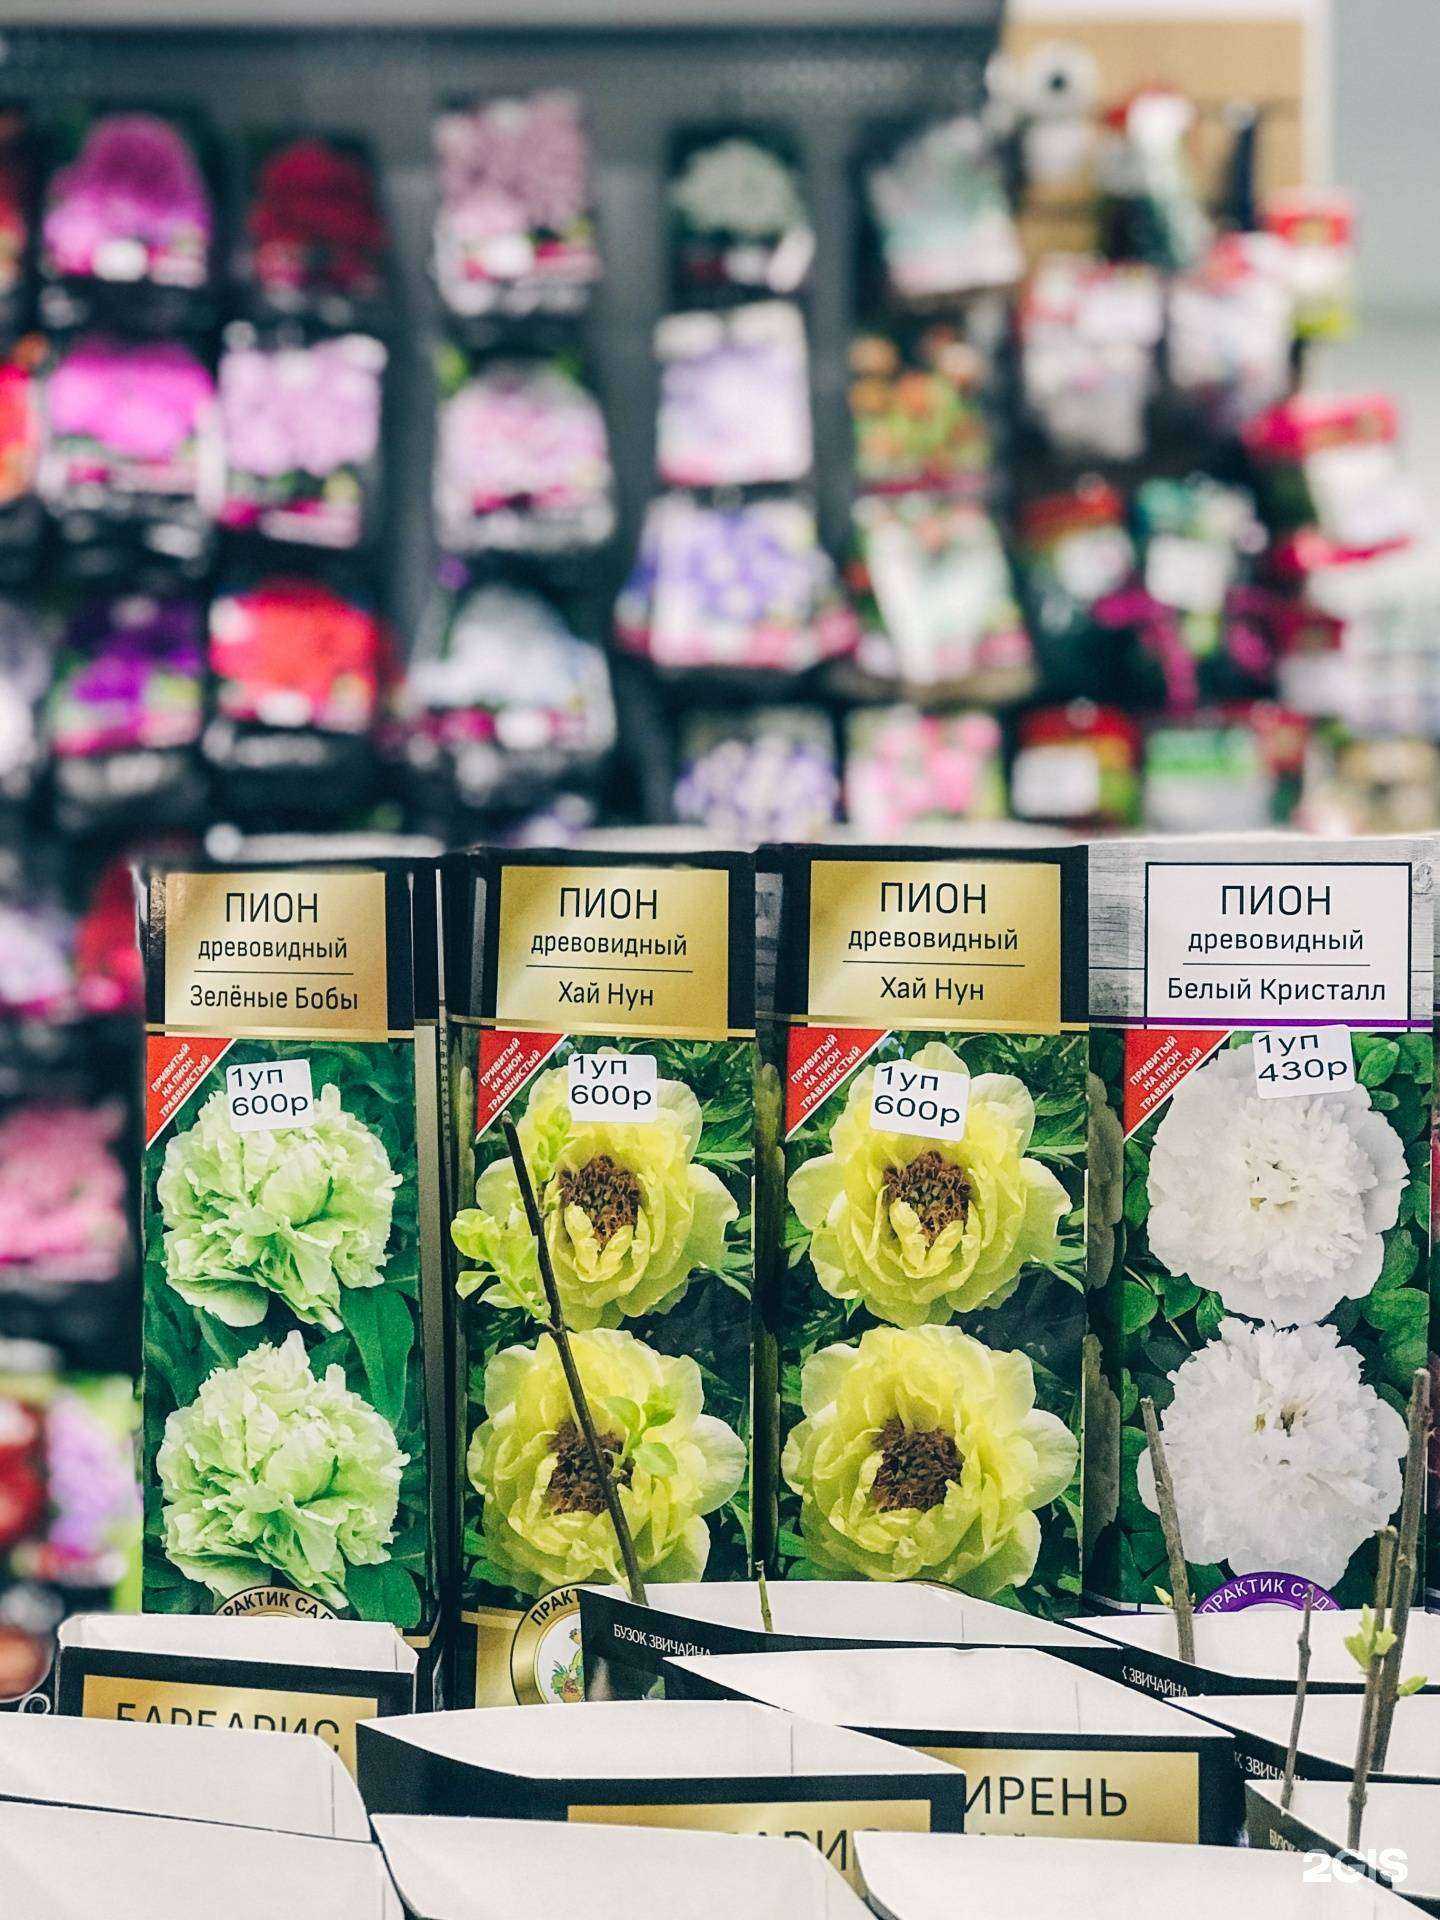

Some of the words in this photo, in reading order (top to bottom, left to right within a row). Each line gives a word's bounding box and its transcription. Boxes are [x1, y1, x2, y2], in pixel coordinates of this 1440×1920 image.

[226, 892, 318, 923] ПИОН
[560, 887, 657, 919] ПИОН
[881, 882, 986, 914] ПИОН
[1221, 885, 1330, 916] ПИОН
[199, 937, 347, 961] древовидный
[531, 934, 687, 957] древовидный
[849, 929, 1018, 952] древовидный
[1188, 929, 1363, 953] древовидный
[191, 984, 287, 1008] Зелёные
[295, 987, 358, 1009] Бобы
[559, 981, 600, 1004] Хай
[608, 984, 653, 1010] Нун
[881, 977, 926, 1000] Хай
[936, 978, 984, 1005] Нун
[1168, 977, 1251, 1000] Белый
[1261, 979, 1386, 1005] Кристалл
[790, 1034, 838, 1085] ПРИВИТЫЙ
[1258, 1034, 1319, 1056] 1уп
[151, 1043, 190, 1093] ПРИВИТЫЙ
[480, 1038, 521, 1087] ПРИВИТЫЙ
[490, 1070, 508, 1092] НА
[503, 1052, 525, 1077] ПИОН
[574, 1055, 627, 1079] 1уп
[803, 1069, 822, 1090] НА
[816, 1049, 842, 1075] ПИОН
[1129, 1036, 1178, 1086] ПРИВИТЫЙ
[1142, 1072, 1162, 1092] НА
[1157, 1050, 1182, 1077] ПИОН
[1258, 1059, 1348, 1082] 430р
[159, 1055, 211, 1118] ТРАВЯНИСТЫЙ
[161, 1077, 178, 1096] НА
[173, 1058, 195, 1082] ПИОН
[232, 1068, 283, 1090] 1уп
[487, 1049, 541, 1111] ТРАВЯНИСТЫЙ
[801, 1046, 862, 1110] ТРАВЯНИСТЫЙ
[881, 1066, 938, 1092] 1уп
[1139, 1047, 1203, 1111] ТРАВЯНИСТЫЙ
[232, 1093, 308, 1116] 600р
[571, 1085, 651, 1110] 600р
[874, 1095, 960, 1127] 600р
[223, 1591, 290, 1616] РАКТИК
[1202, 1578, 1286, 1613] ПРАКТИК
[613, 1623, 647, 1646] БУЗОК
[648, 1634, 711, 1656] ЗВИЧАЙНА
[1129, 1668, 1189, 1697] ЗВИЧАЙНА
[964, 1776, 1128, 1816] ИРЕНЬ
